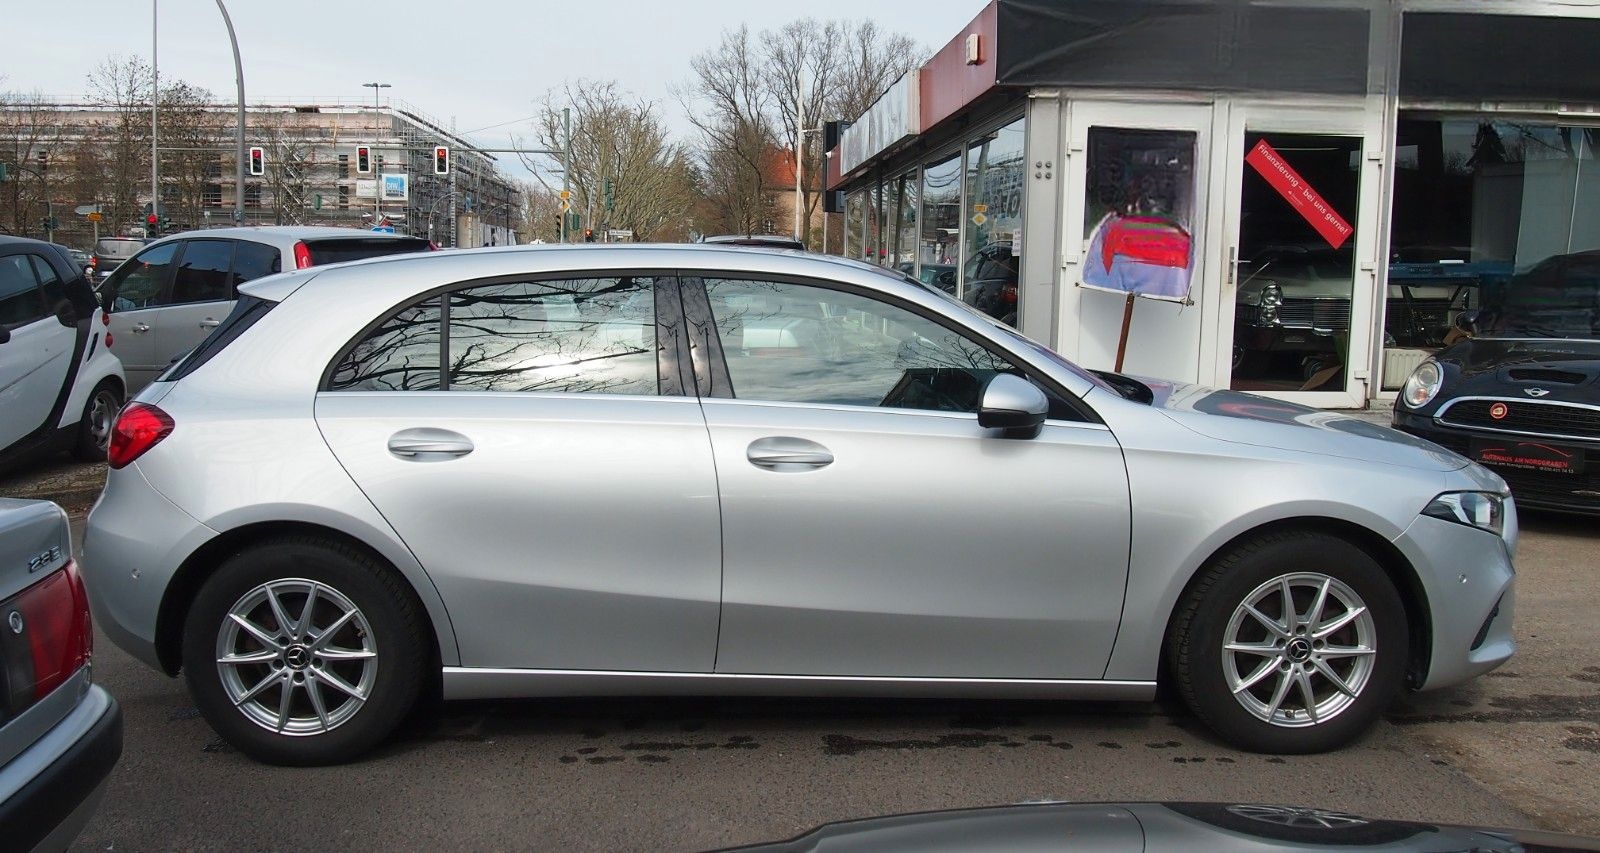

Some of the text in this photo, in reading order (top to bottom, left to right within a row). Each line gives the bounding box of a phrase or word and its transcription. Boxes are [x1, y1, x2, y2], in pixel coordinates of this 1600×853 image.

[1258, 144, 1299, 187] Finanzierung
[1302, 188, 1315, 202] bei
[1313, 200, 1327, 214] uns
[1324, 212, 1349, 235] gerne!
